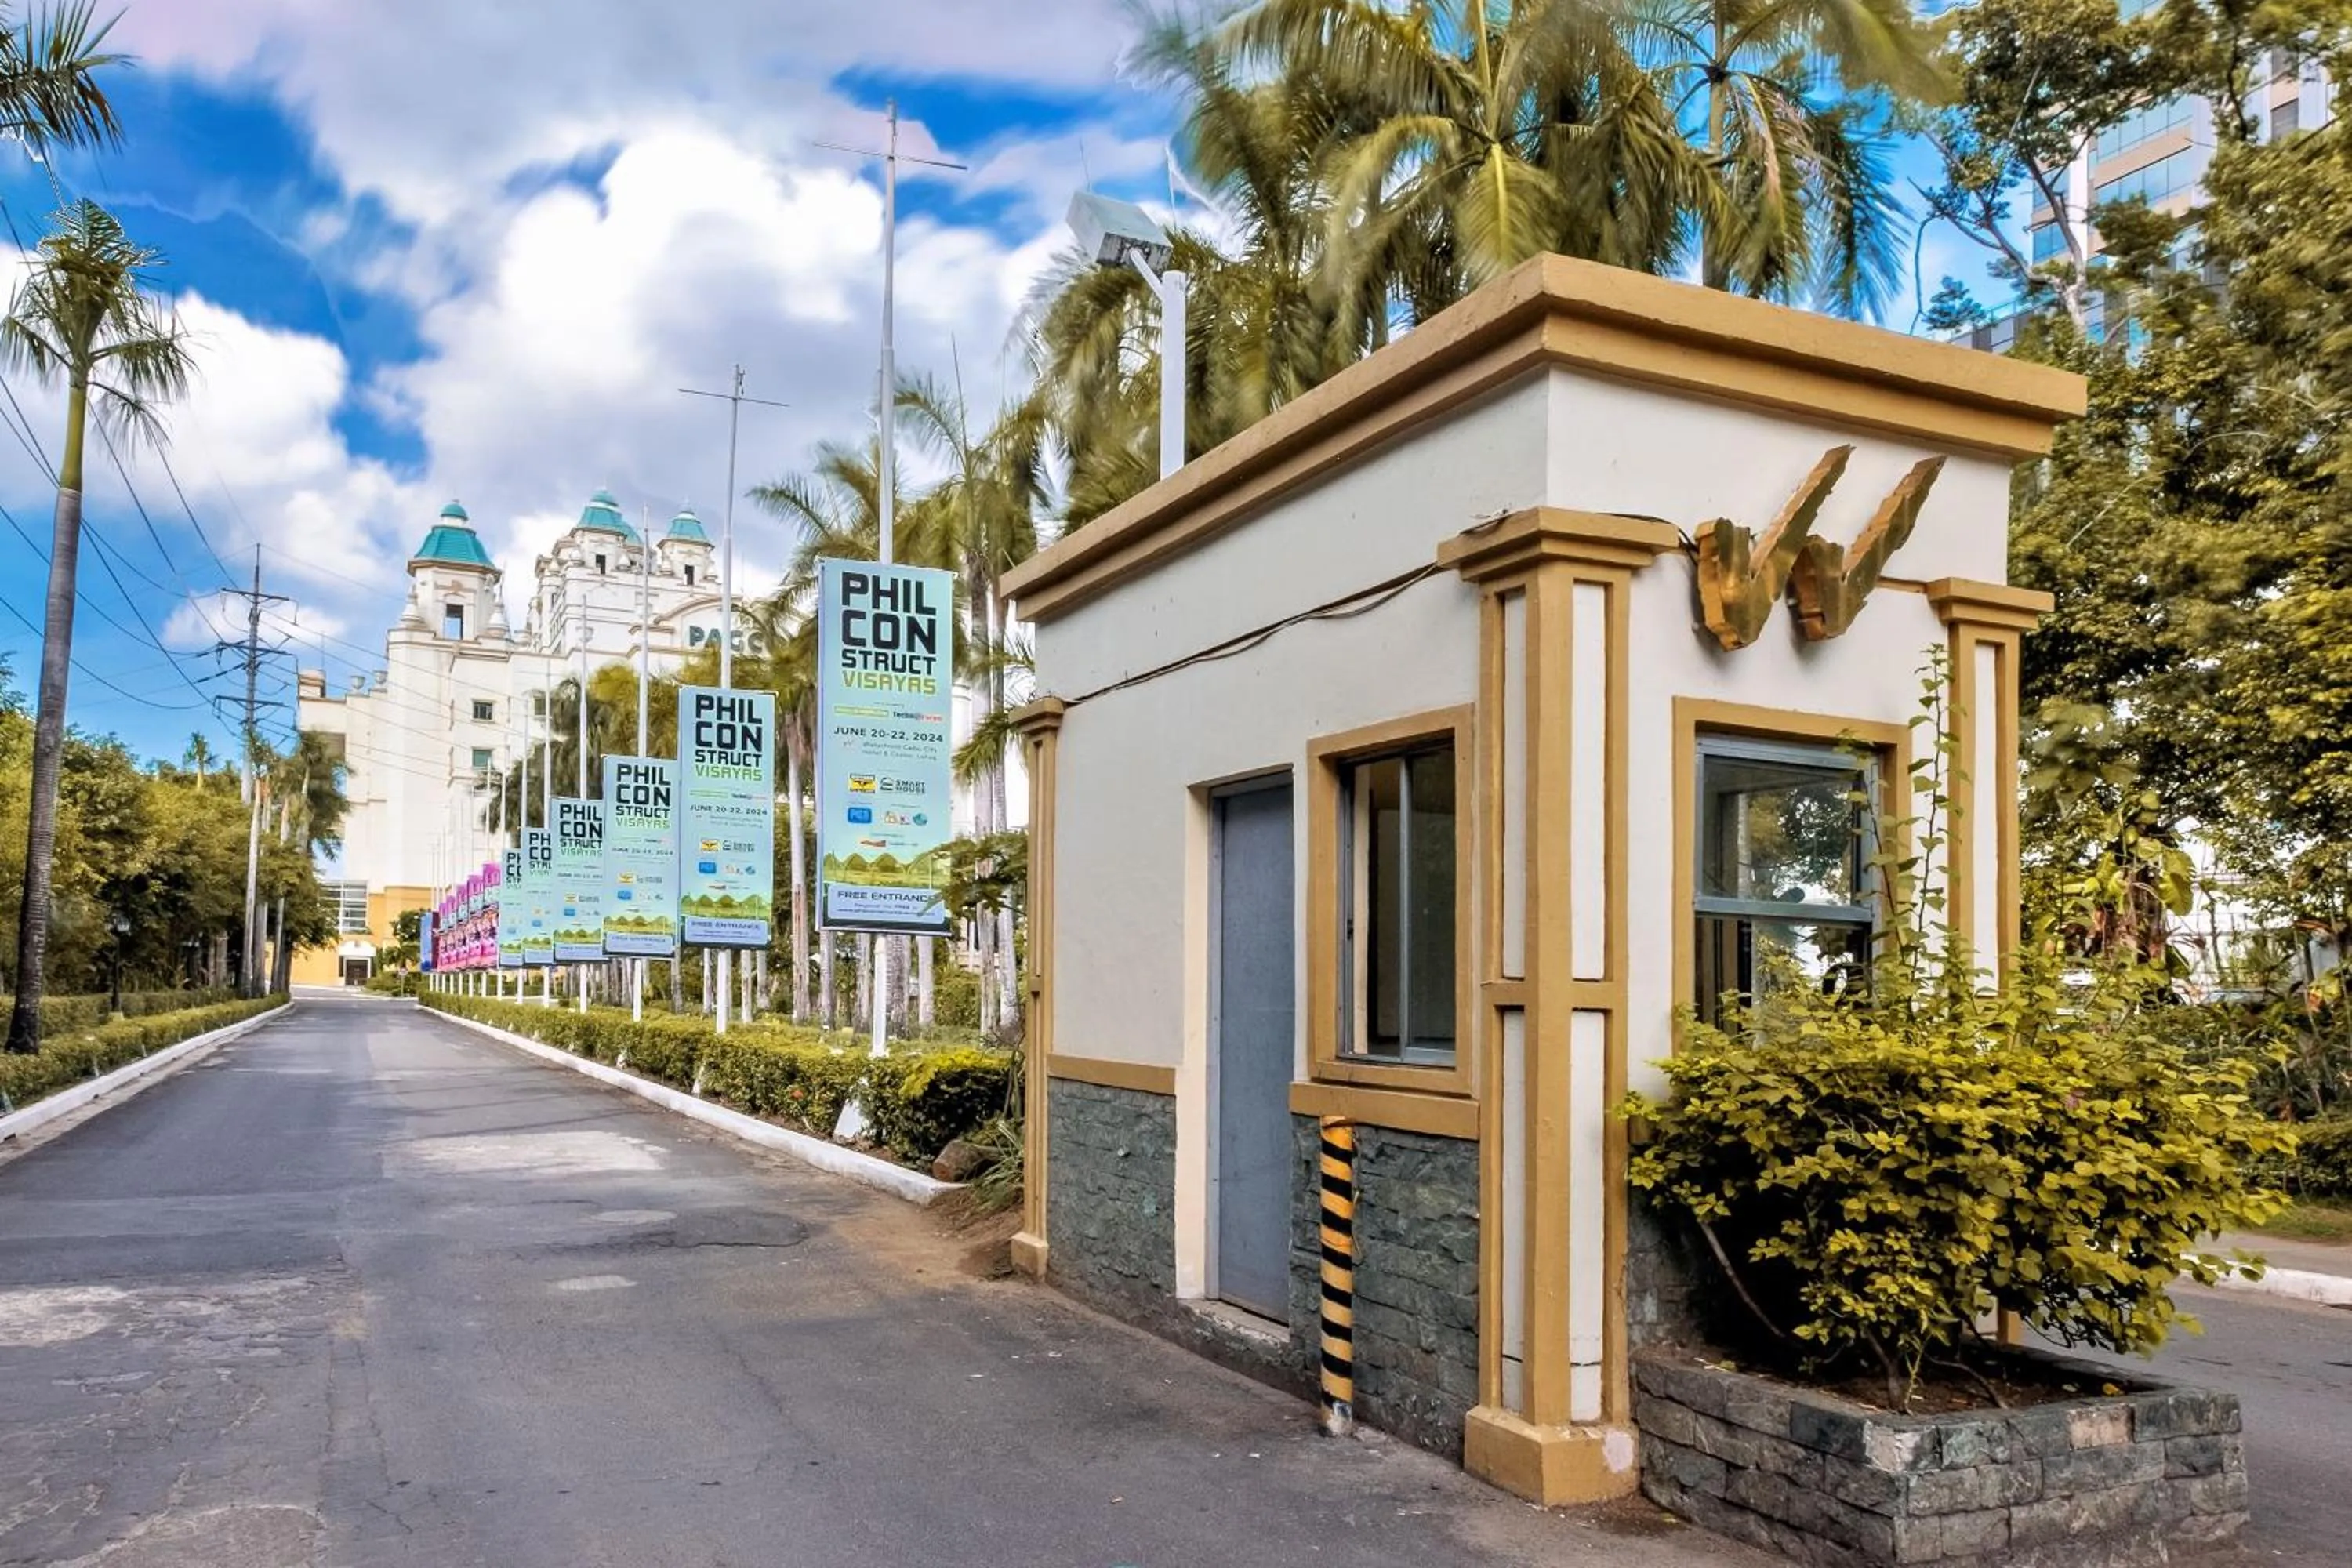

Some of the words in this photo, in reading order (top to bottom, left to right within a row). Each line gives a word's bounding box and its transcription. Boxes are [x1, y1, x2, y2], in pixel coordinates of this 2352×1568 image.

[841, 572, 936, 615] PHIL
[841, 609, 936, 654] CON
[841, 648, 937, 675] STRUCT
[842, 670, 936, 695] VISAYAS
[695, 695, 762, 724] PHIL
[695, 720, 762, 752] CON
[834, 727, 866, 737] JUNE
[870, 728, 909, 741] 20-22,
[913, 732, 943, 742] 2024
[695, 750, 762, 767] STRUCT
[617, 764, 671, 786] PHIL
[695, 764, 762, 781] VISAYAS
[616, 784, 670, 807] CON
[560, 804, 602, 822] PHIL
[615, 805, 670, 818] STRUCT
[560, 821, 602, 839] CON
[615, 817, 670, 829] VISAYAS
[529, 833, 550, 845] PH
[559, 838, 602, 848] STRUCT
[529, 847, 551, 861] CO
[837, 891, 867, 899] FREE
[871, 892, 931, 902] ENTRANC
